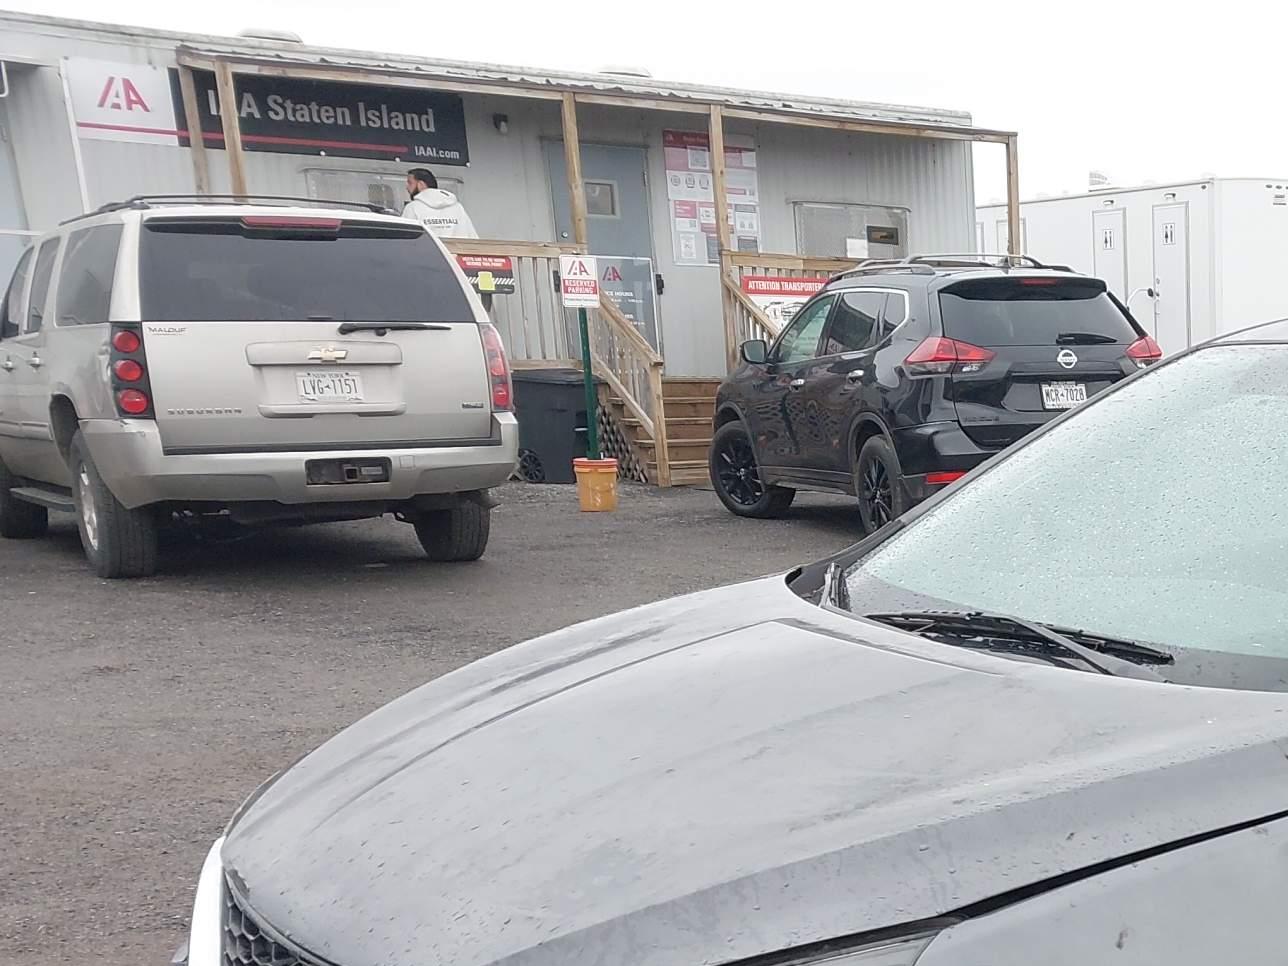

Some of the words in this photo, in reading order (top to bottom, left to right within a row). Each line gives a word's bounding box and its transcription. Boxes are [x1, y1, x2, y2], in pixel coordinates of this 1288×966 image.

[207, 89, 261, 119] IA
[266, 94, 352, 126] Staten
[358, 102, 436, 133] Island
[414, 145, 460, 160] IAAI.com
[564, 279, 595, 288] RESERVED
[748, 280, 780, 291] ATTENTION
[567, 286, 594, 294] PARKING
